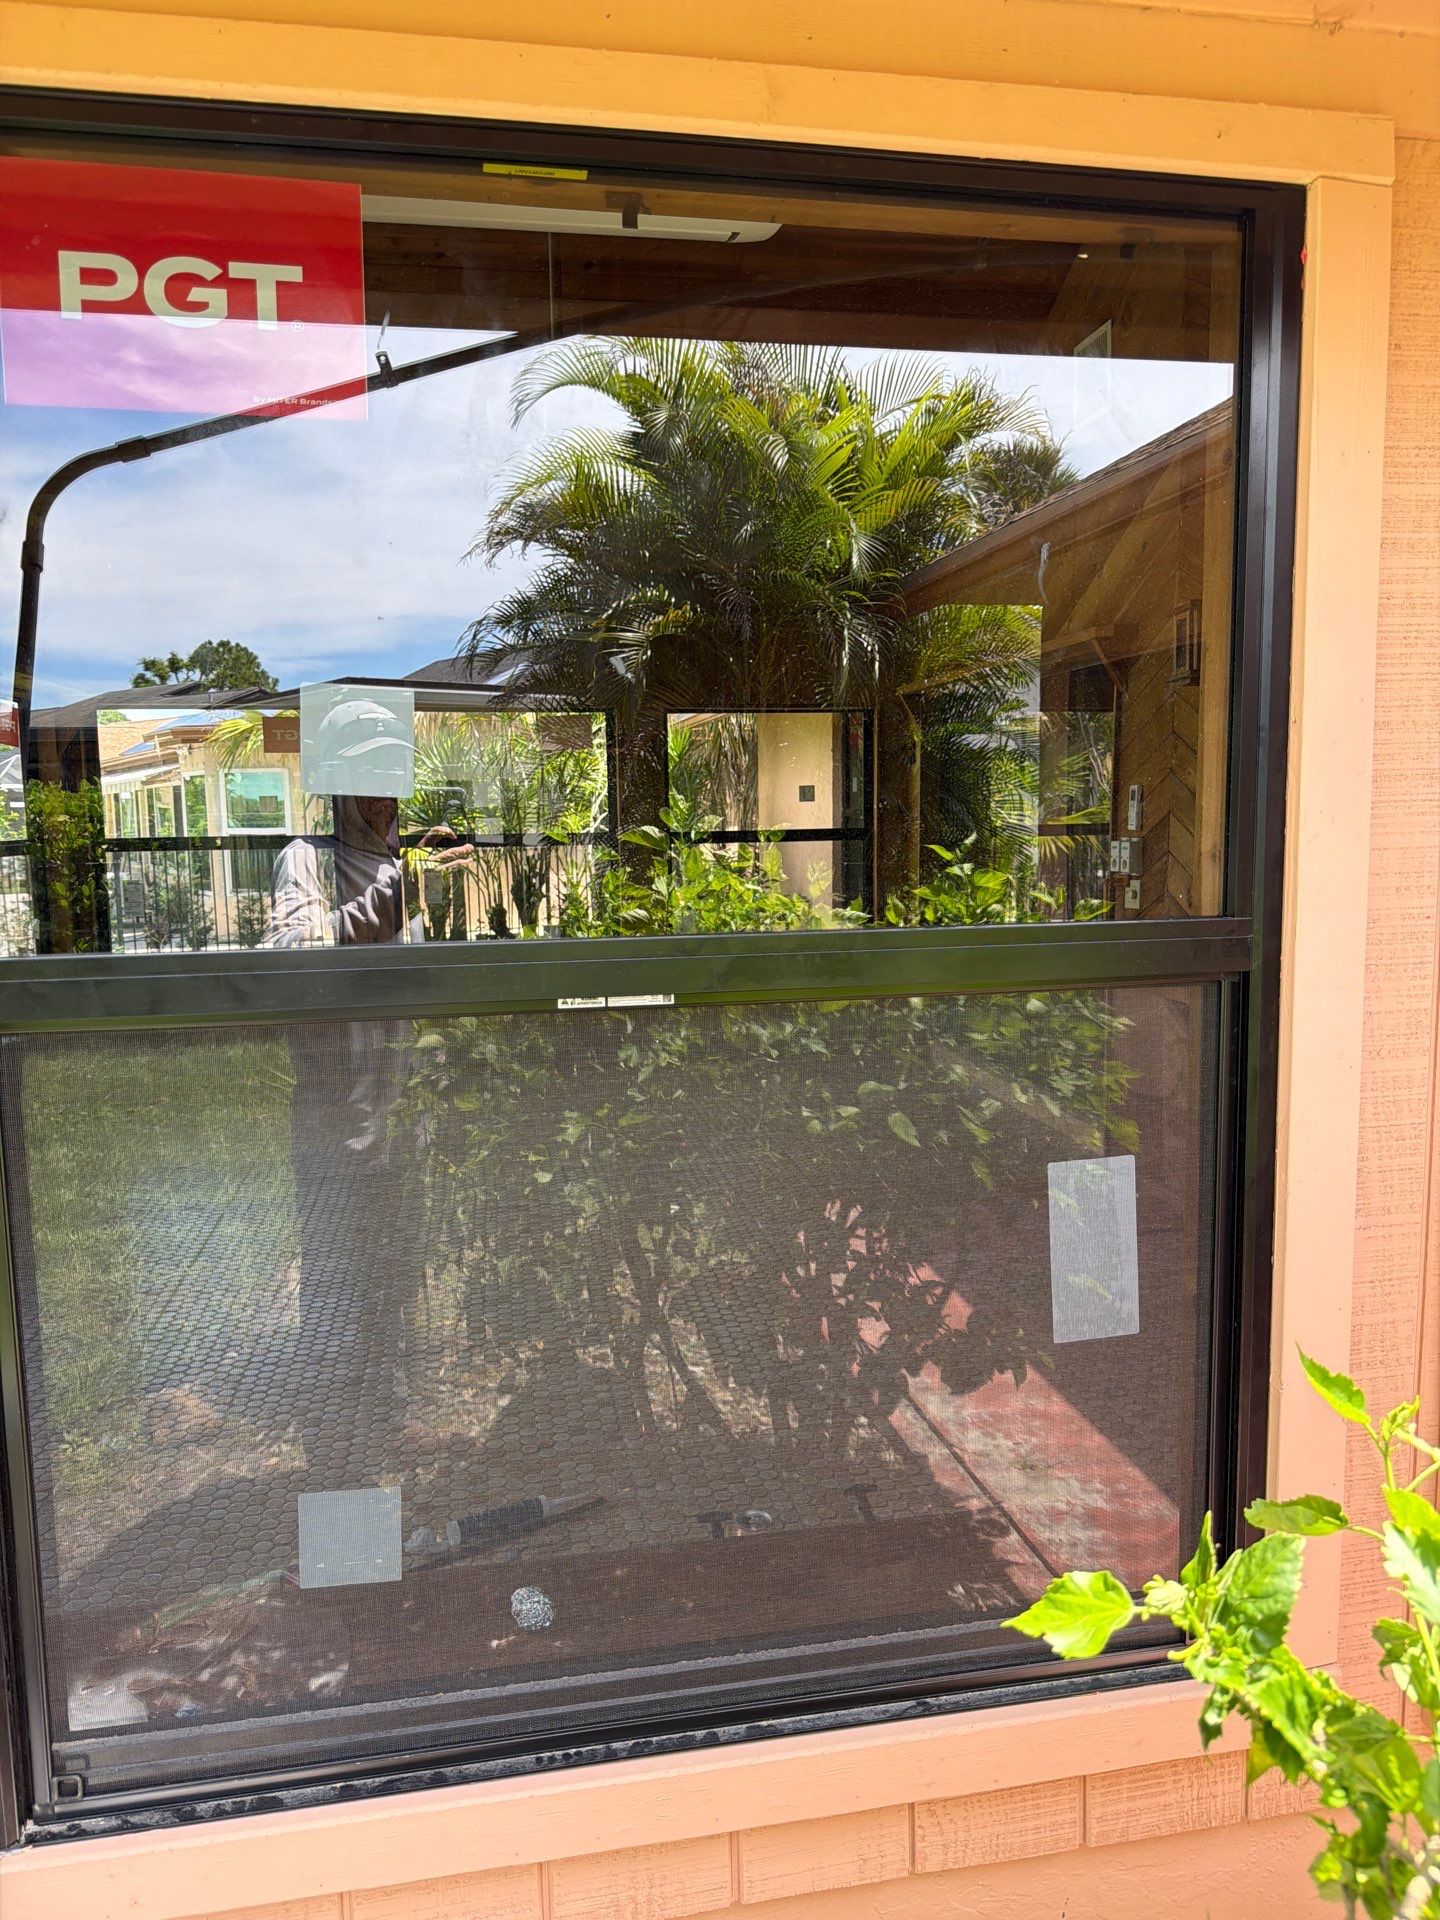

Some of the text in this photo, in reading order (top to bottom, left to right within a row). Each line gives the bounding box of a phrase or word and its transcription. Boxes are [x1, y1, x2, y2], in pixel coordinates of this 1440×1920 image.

[57, 249, 304, 332] PGT
[253, 395, 265, 404] By
[267, 396, 298, 405] MITER
